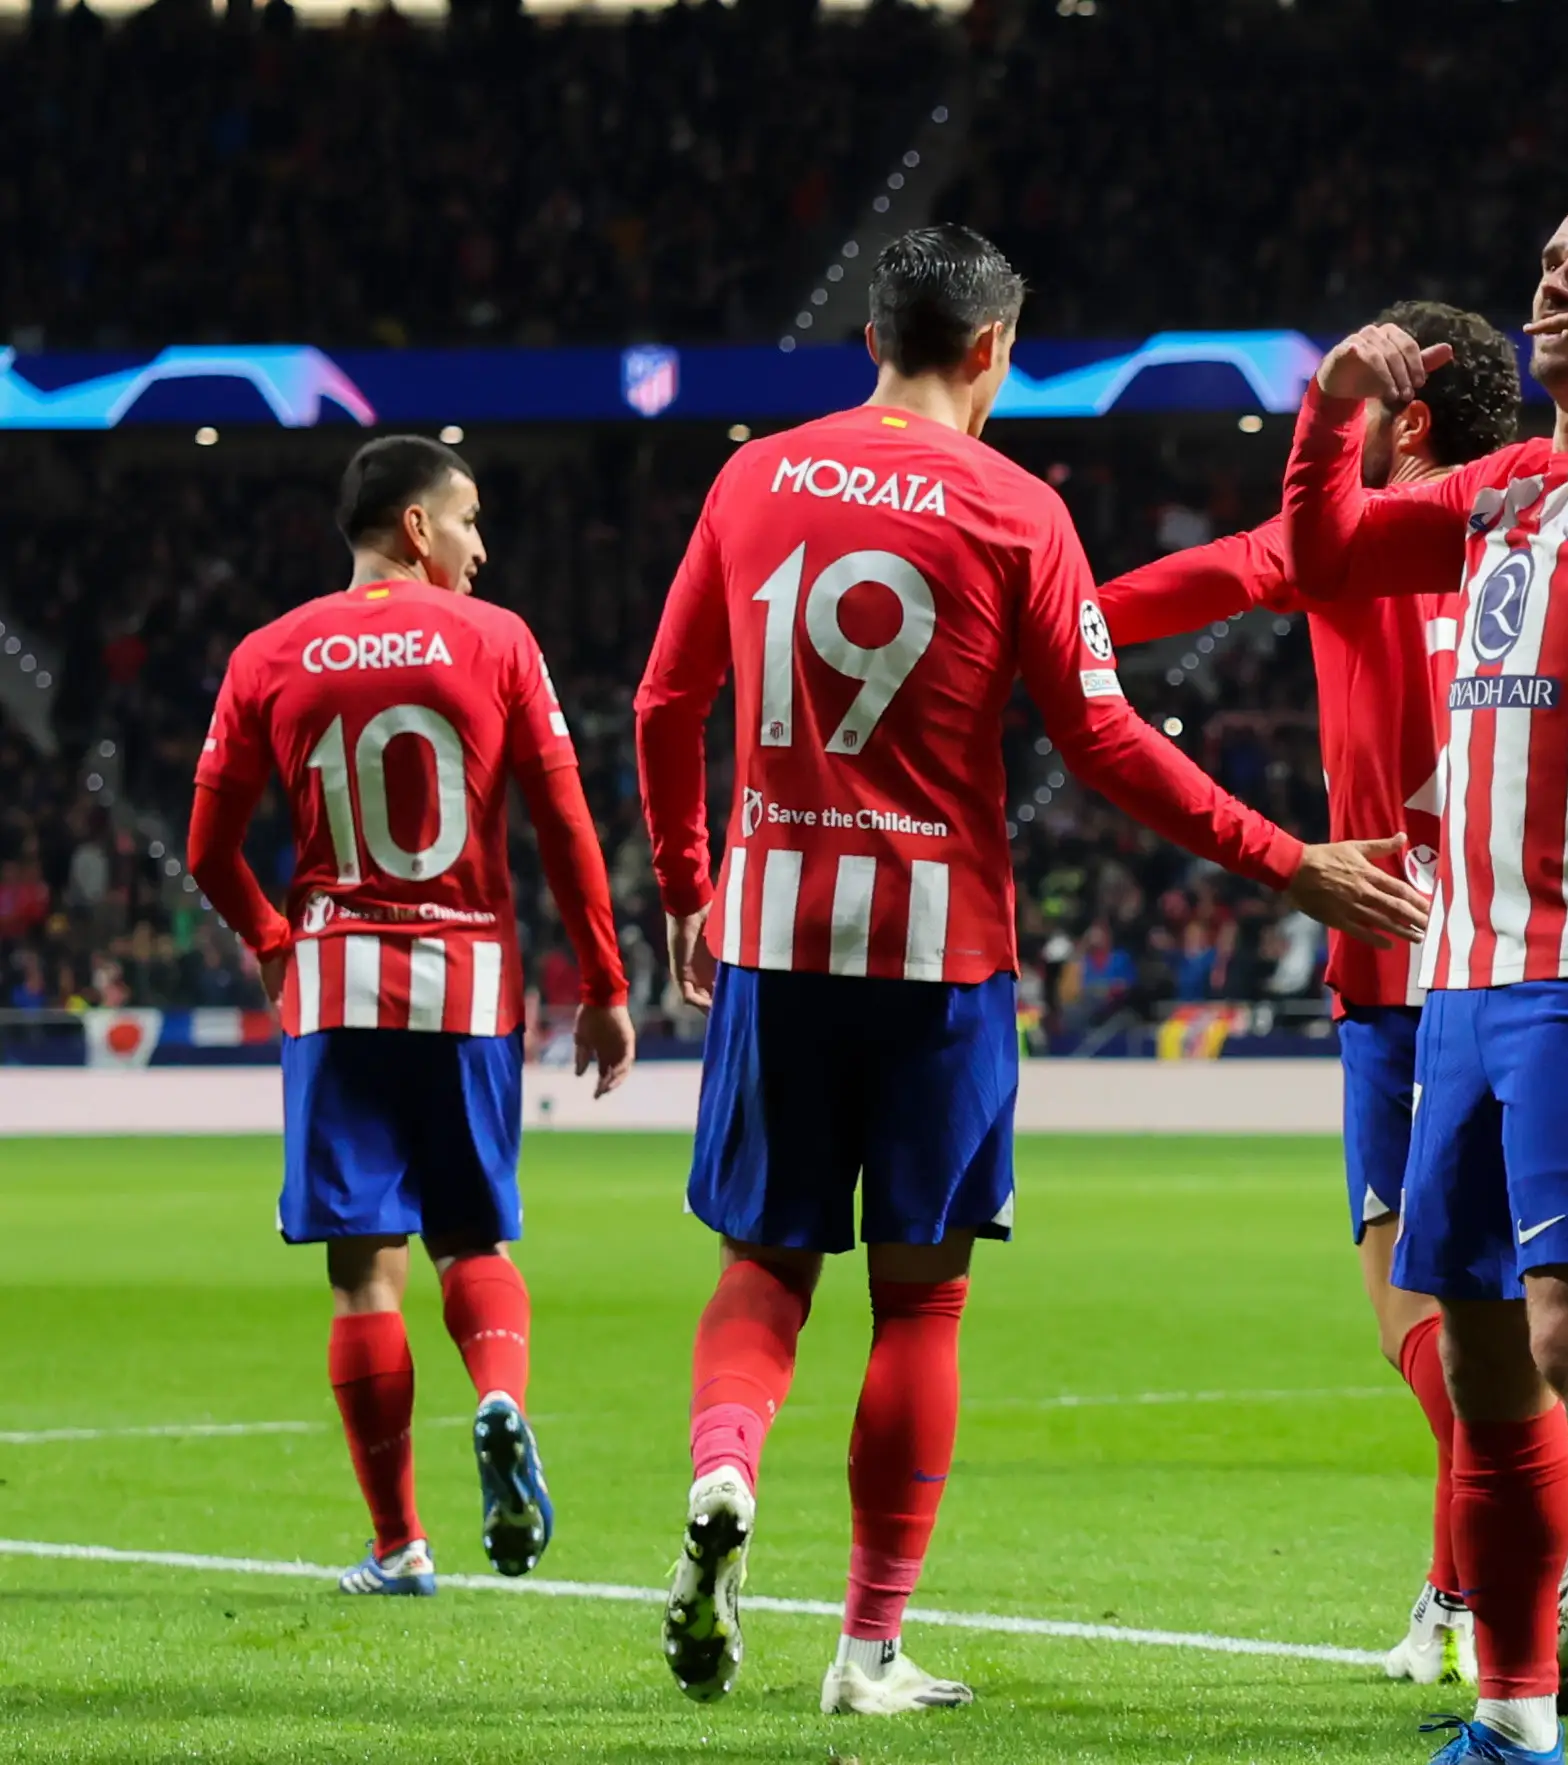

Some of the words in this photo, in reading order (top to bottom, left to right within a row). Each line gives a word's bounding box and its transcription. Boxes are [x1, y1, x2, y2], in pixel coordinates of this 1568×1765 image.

[770, 456, 946, 516] MORATA
[302, 629, 453, 674] CORREA
[751, 540, 936, 755] 19
[1507, 679, 1553, 706] AIR
[306, 703, 469, 885] 10
[767, 802, 817, 826] Save
[821, 807, 853, 829] the
[855, 808, 949, 838] Children
